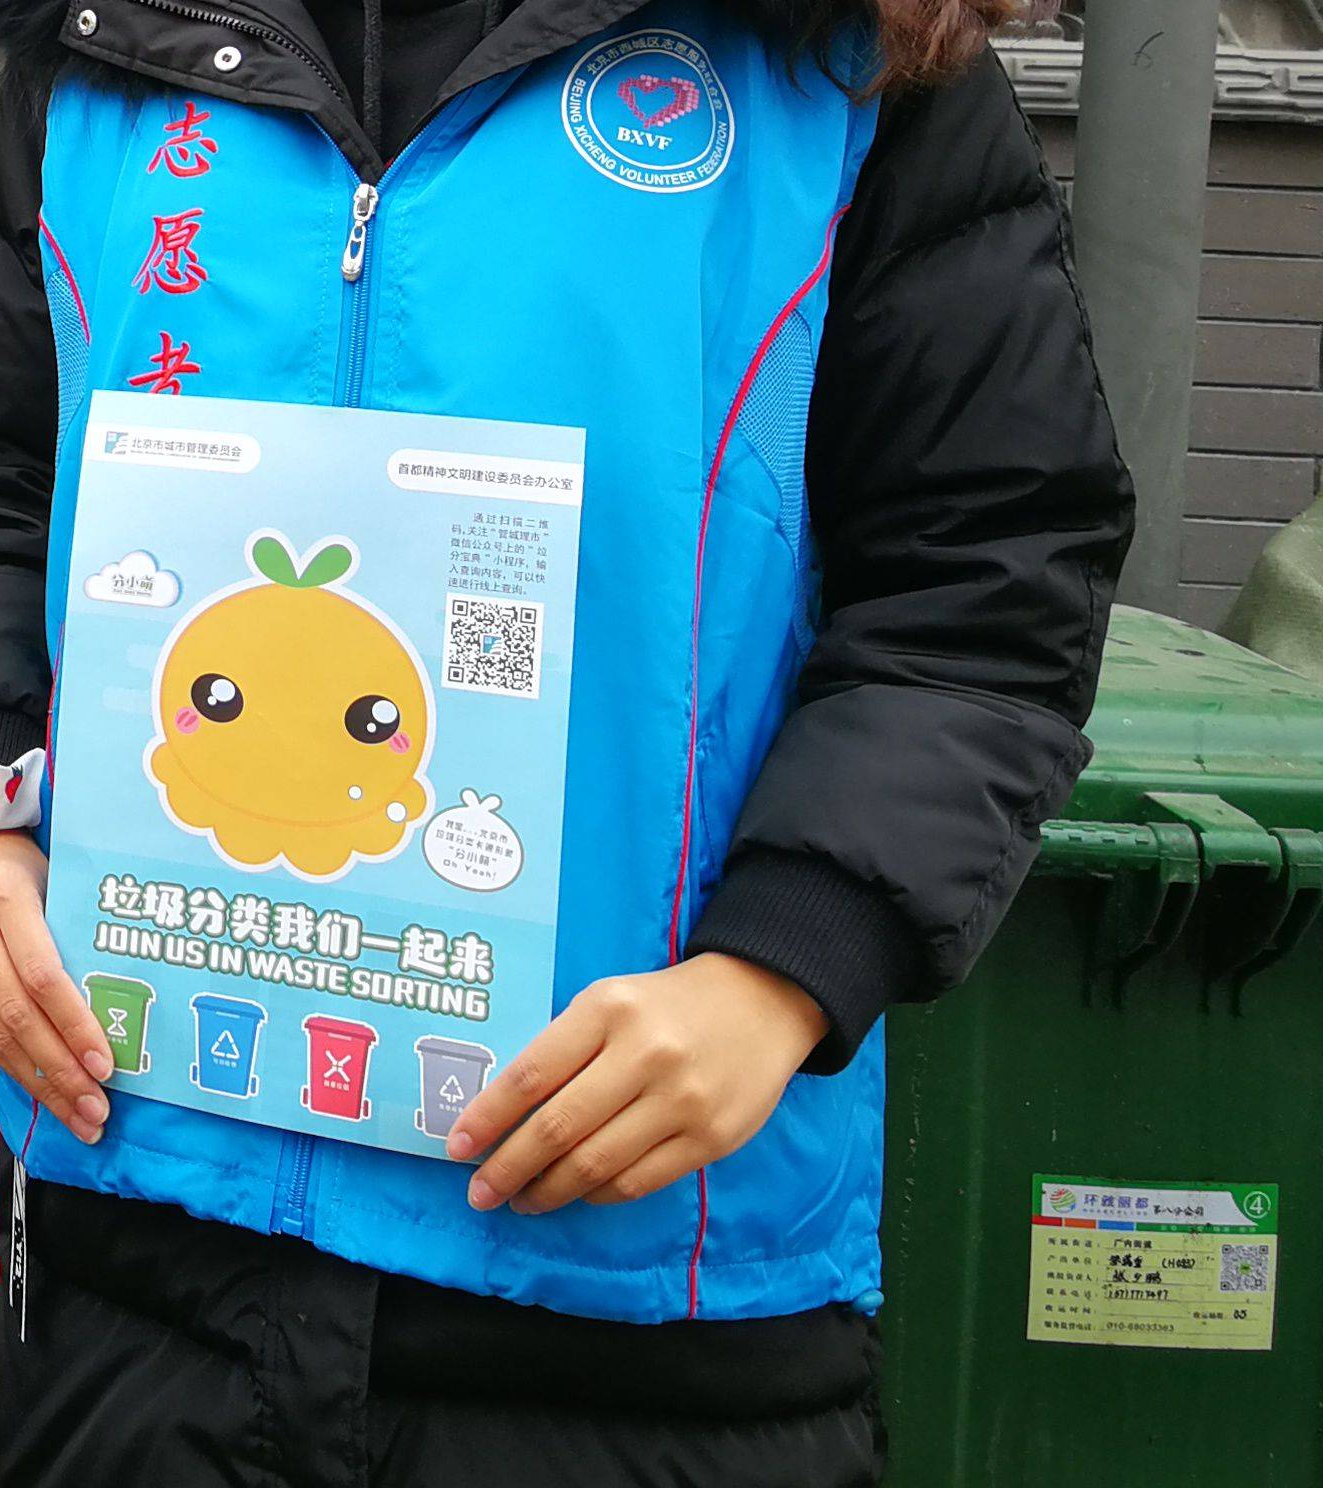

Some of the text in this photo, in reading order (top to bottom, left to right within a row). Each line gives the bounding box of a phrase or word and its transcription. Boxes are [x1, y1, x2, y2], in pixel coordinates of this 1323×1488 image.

[569, 77, 727, 185] BEIJING XICHENG VOLUNTEER FEDERATION
[617, 127, 673, 150] BXVF
[132, 437, 242, 457] 北京市城市管理委员会
[398, 462, 573, 491] 首都精神文明建设委员会办公室
[101, 874, 493, 983] 垃圾分类我们一起来
[96, 923, 488, 1021] JOIN US IN WASTE SORTING
[1249, 1195, 1264, 1214] 4
